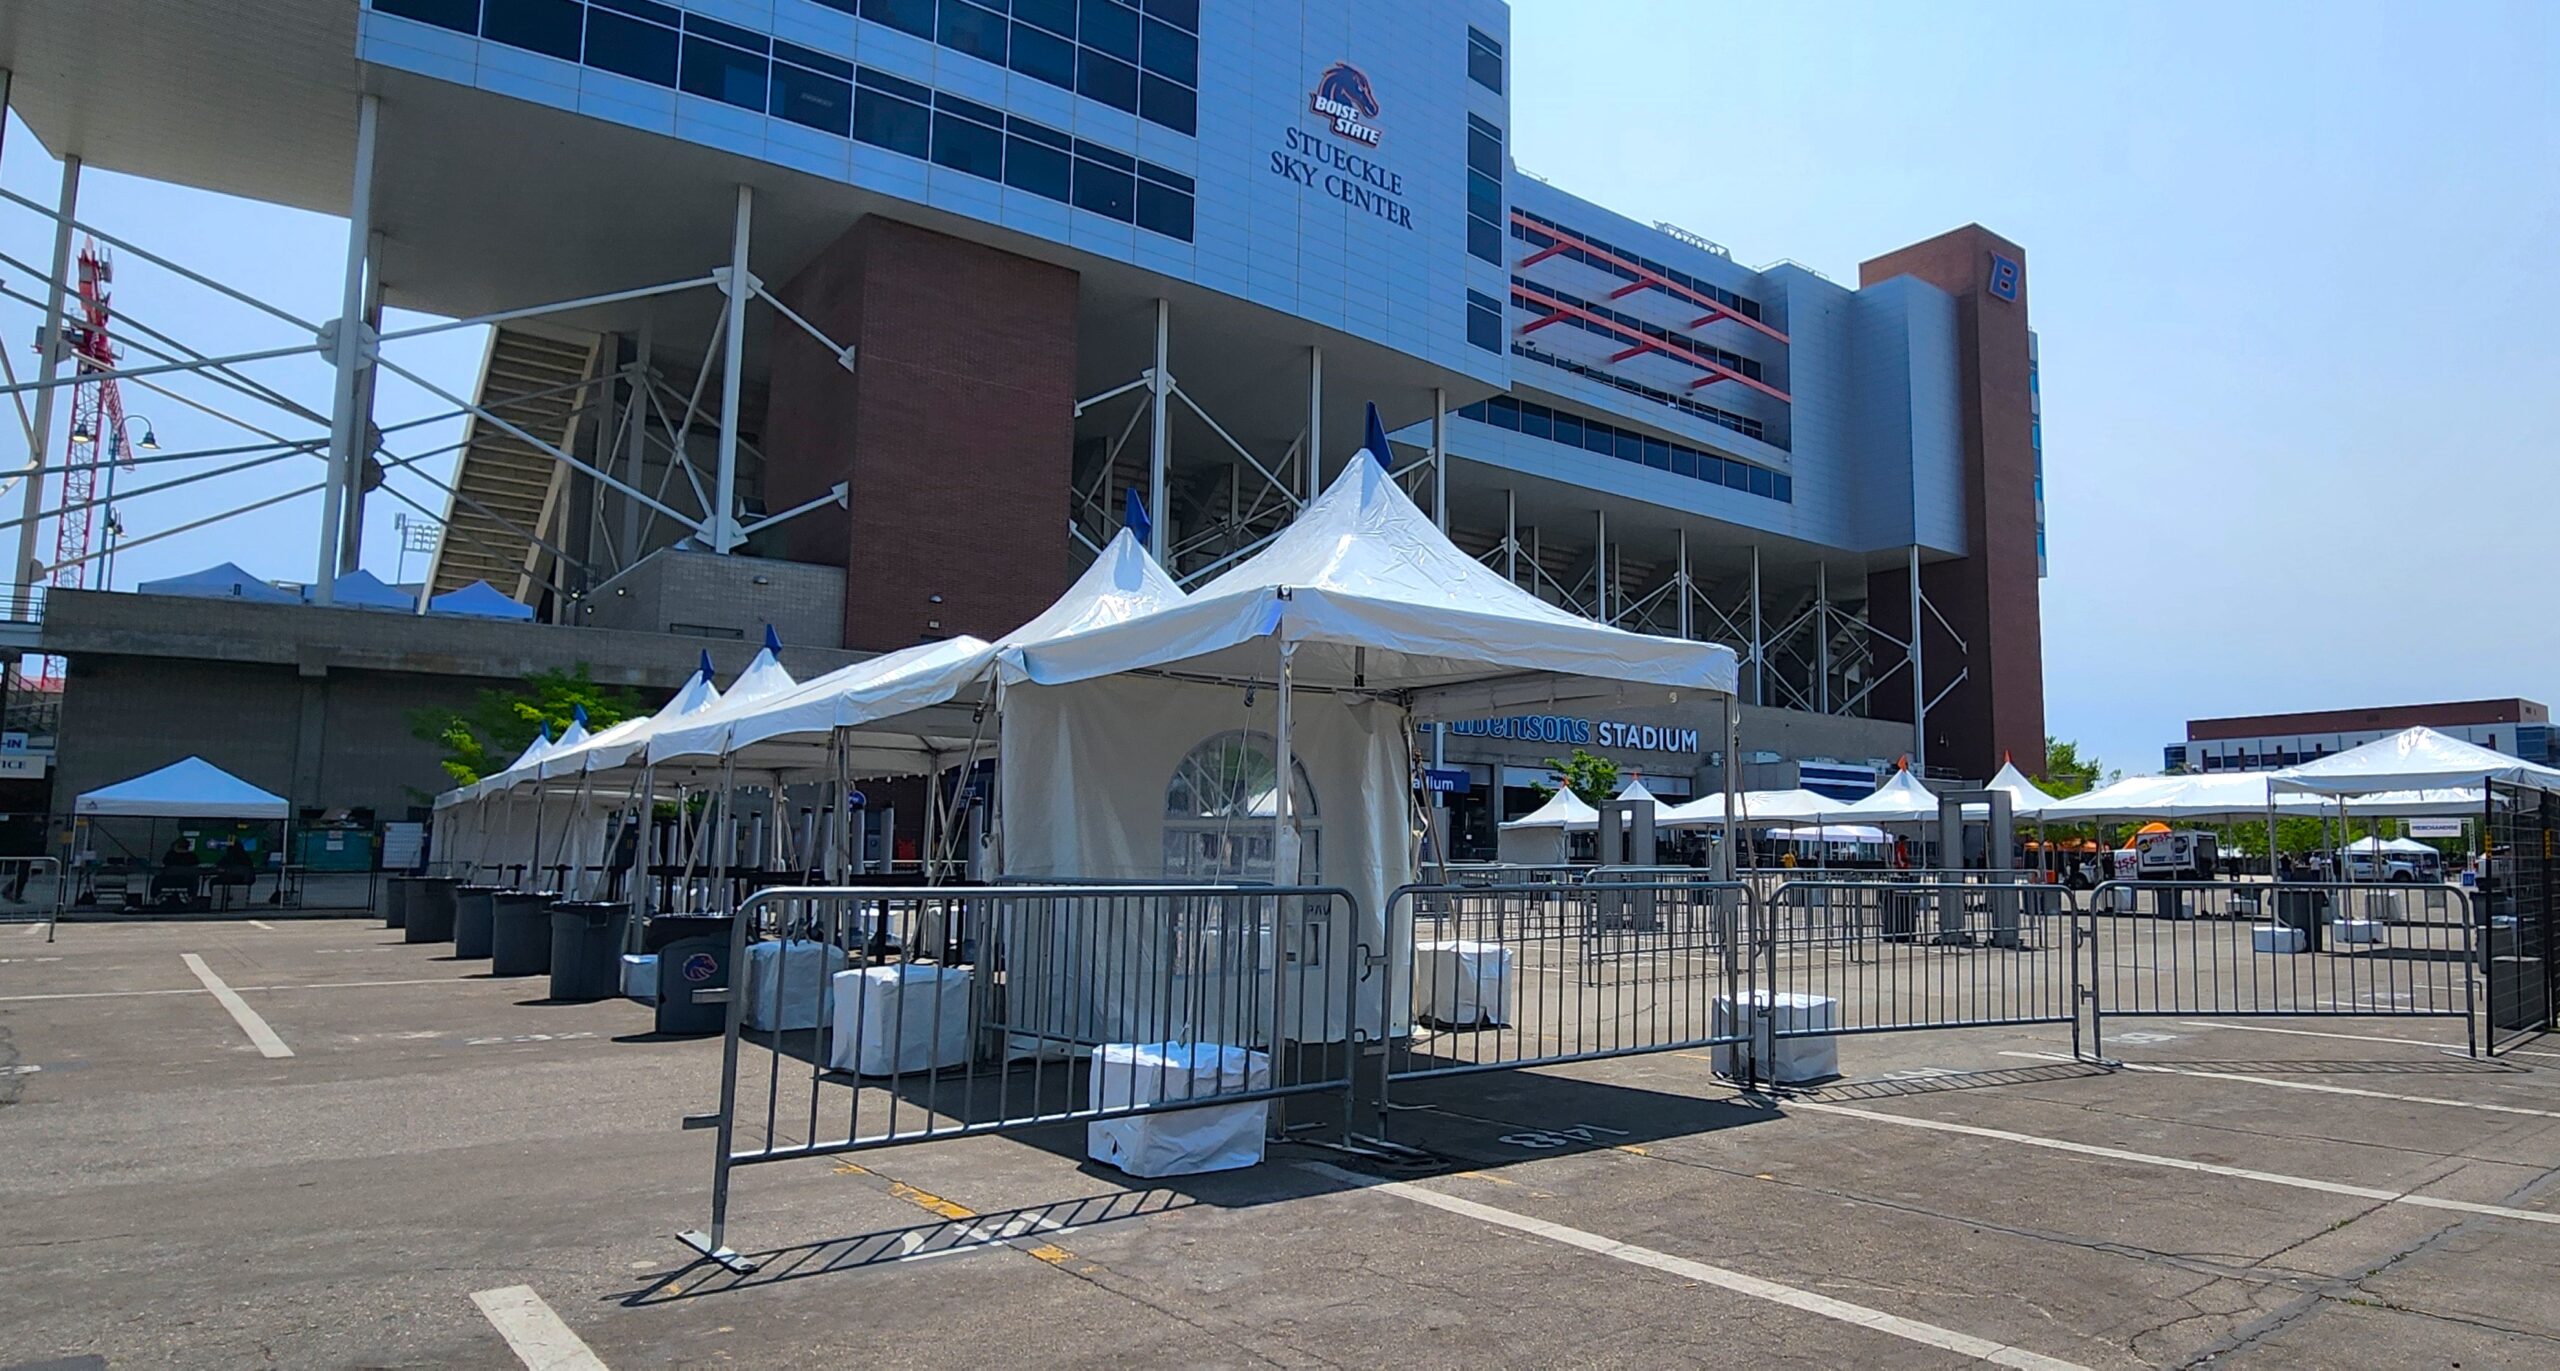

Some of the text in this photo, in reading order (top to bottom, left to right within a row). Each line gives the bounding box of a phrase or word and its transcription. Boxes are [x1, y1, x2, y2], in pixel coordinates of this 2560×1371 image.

[1314, 96, 1360, 122] BOISE
[1334, 118, 1380, 145] STATE
[1285, 126, 1403, 196] STUECKLE
[1270, 150, 1414, 230] SKY CENTER
[1598, 721, 1697, 754] STADIUM
